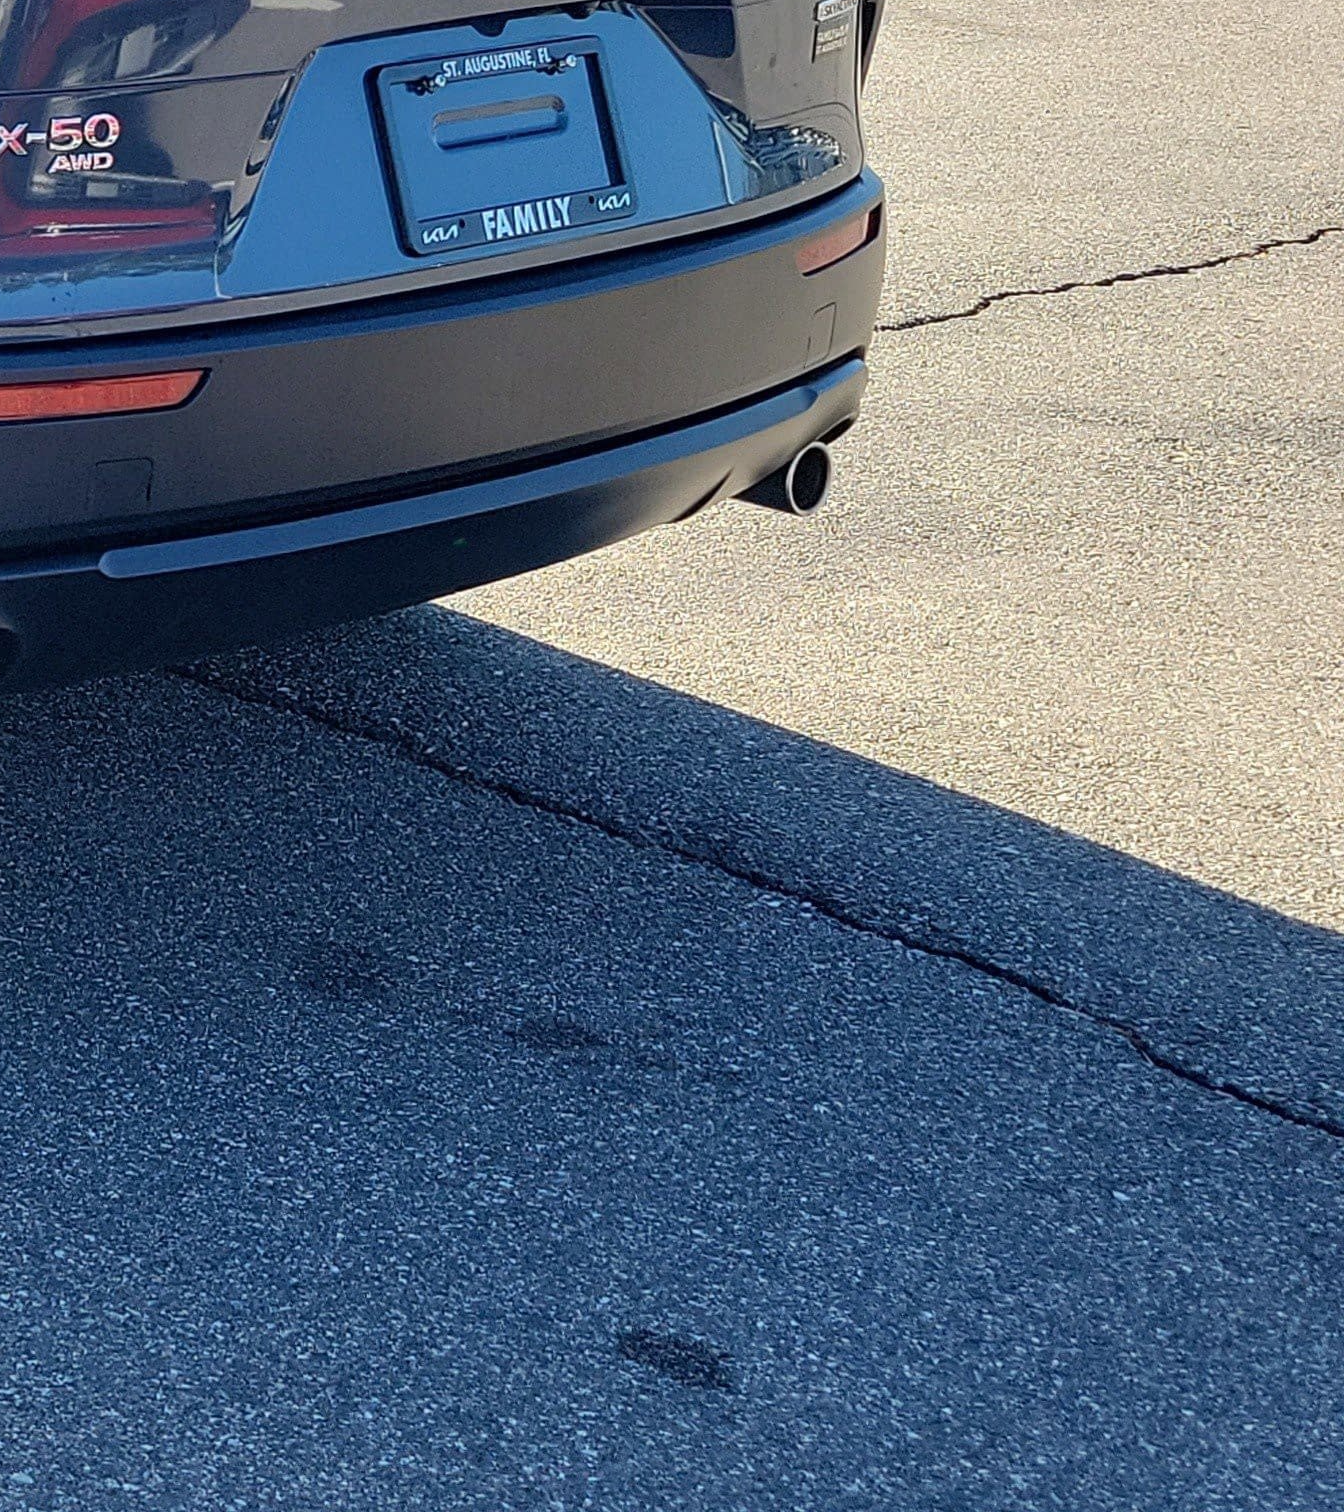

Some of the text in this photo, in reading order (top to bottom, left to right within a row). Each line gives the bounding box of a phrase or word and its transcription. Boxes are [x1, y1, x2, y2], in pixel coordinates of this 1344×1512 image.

[442, 47, 552, 78] ST. AUGUSTINE, FL
[47, 152, 115, 174] AWD
[481, 196, 572, 241] FAMILY
